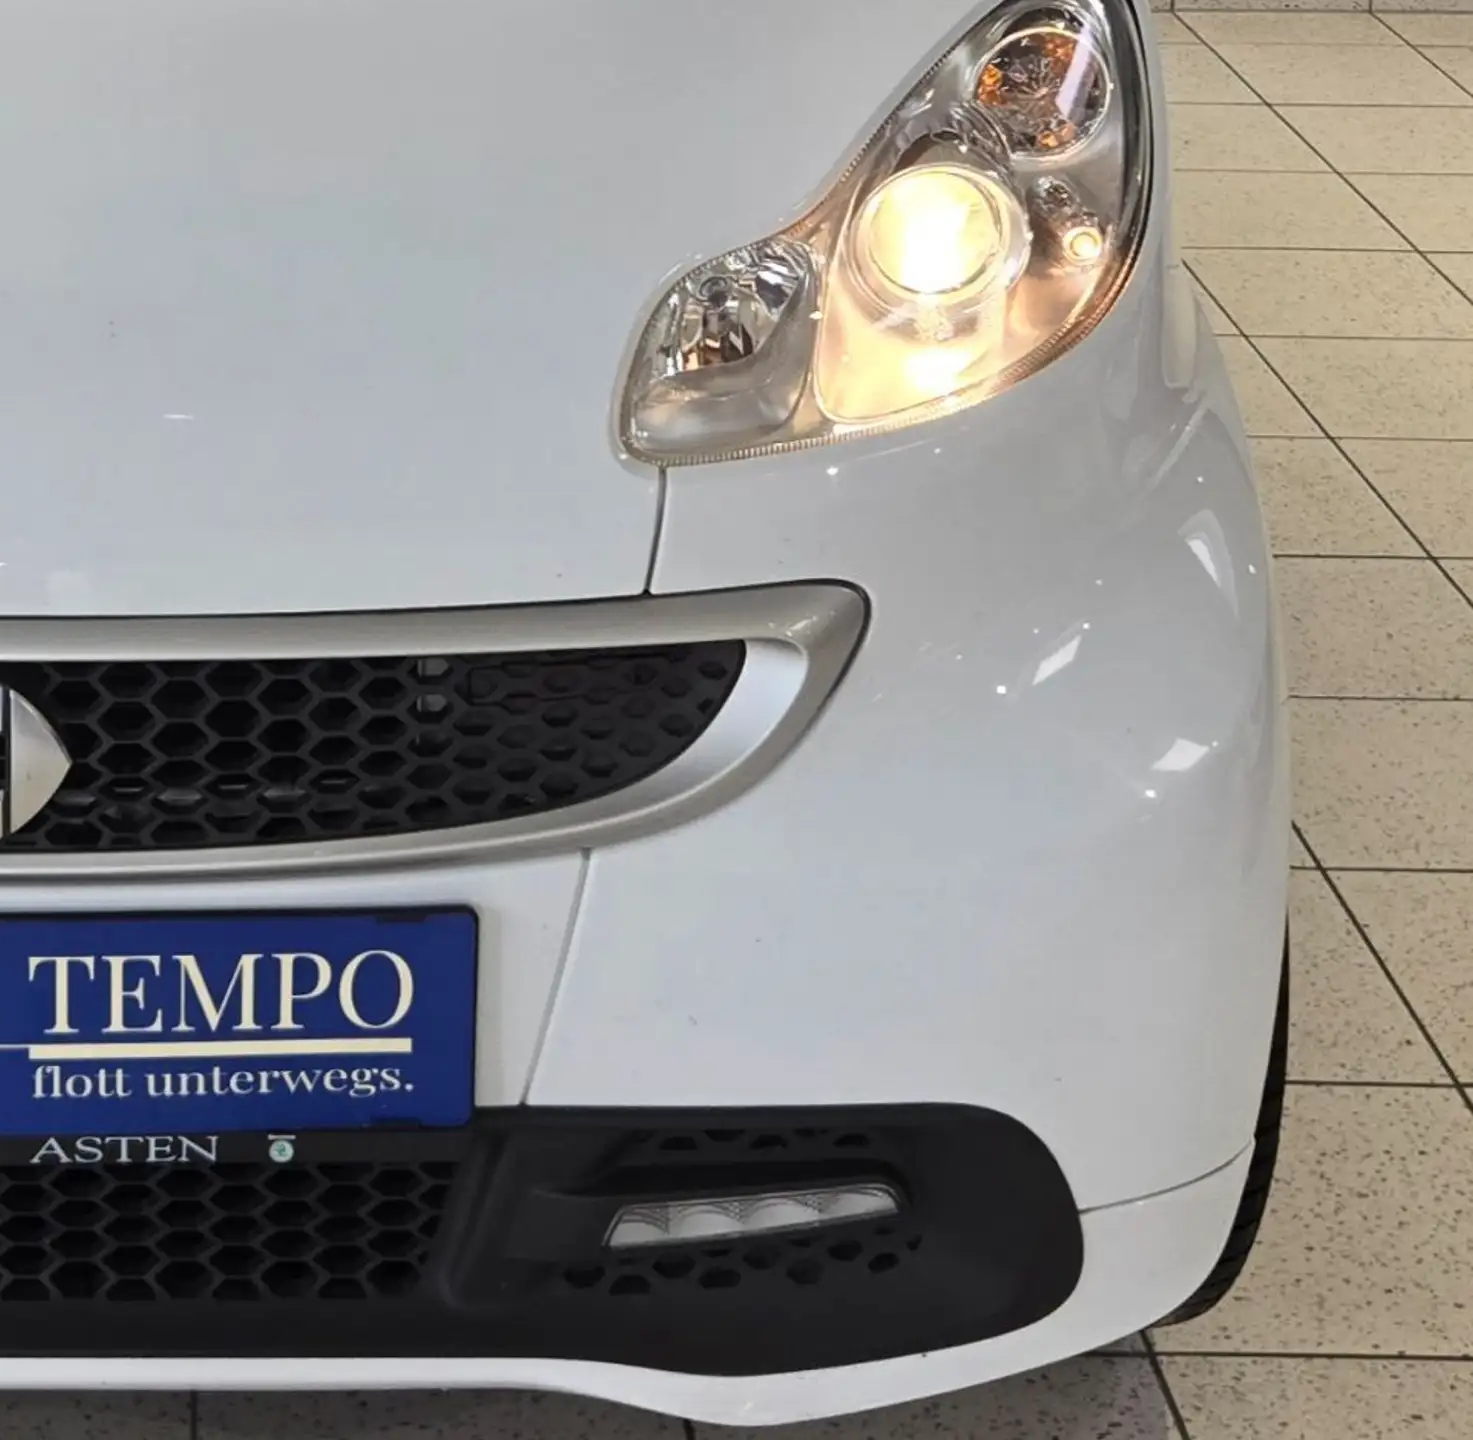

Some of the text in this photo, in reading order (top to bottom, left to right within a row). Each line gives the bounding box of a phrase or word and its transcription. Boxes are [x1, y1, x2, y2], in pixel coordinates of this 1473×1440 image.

[28, 949, 415, 1035] TEMPO
[32, 1065, 416, 1099] flott unterwegs.
[30, 1135, 219, 1165] ASTEN
